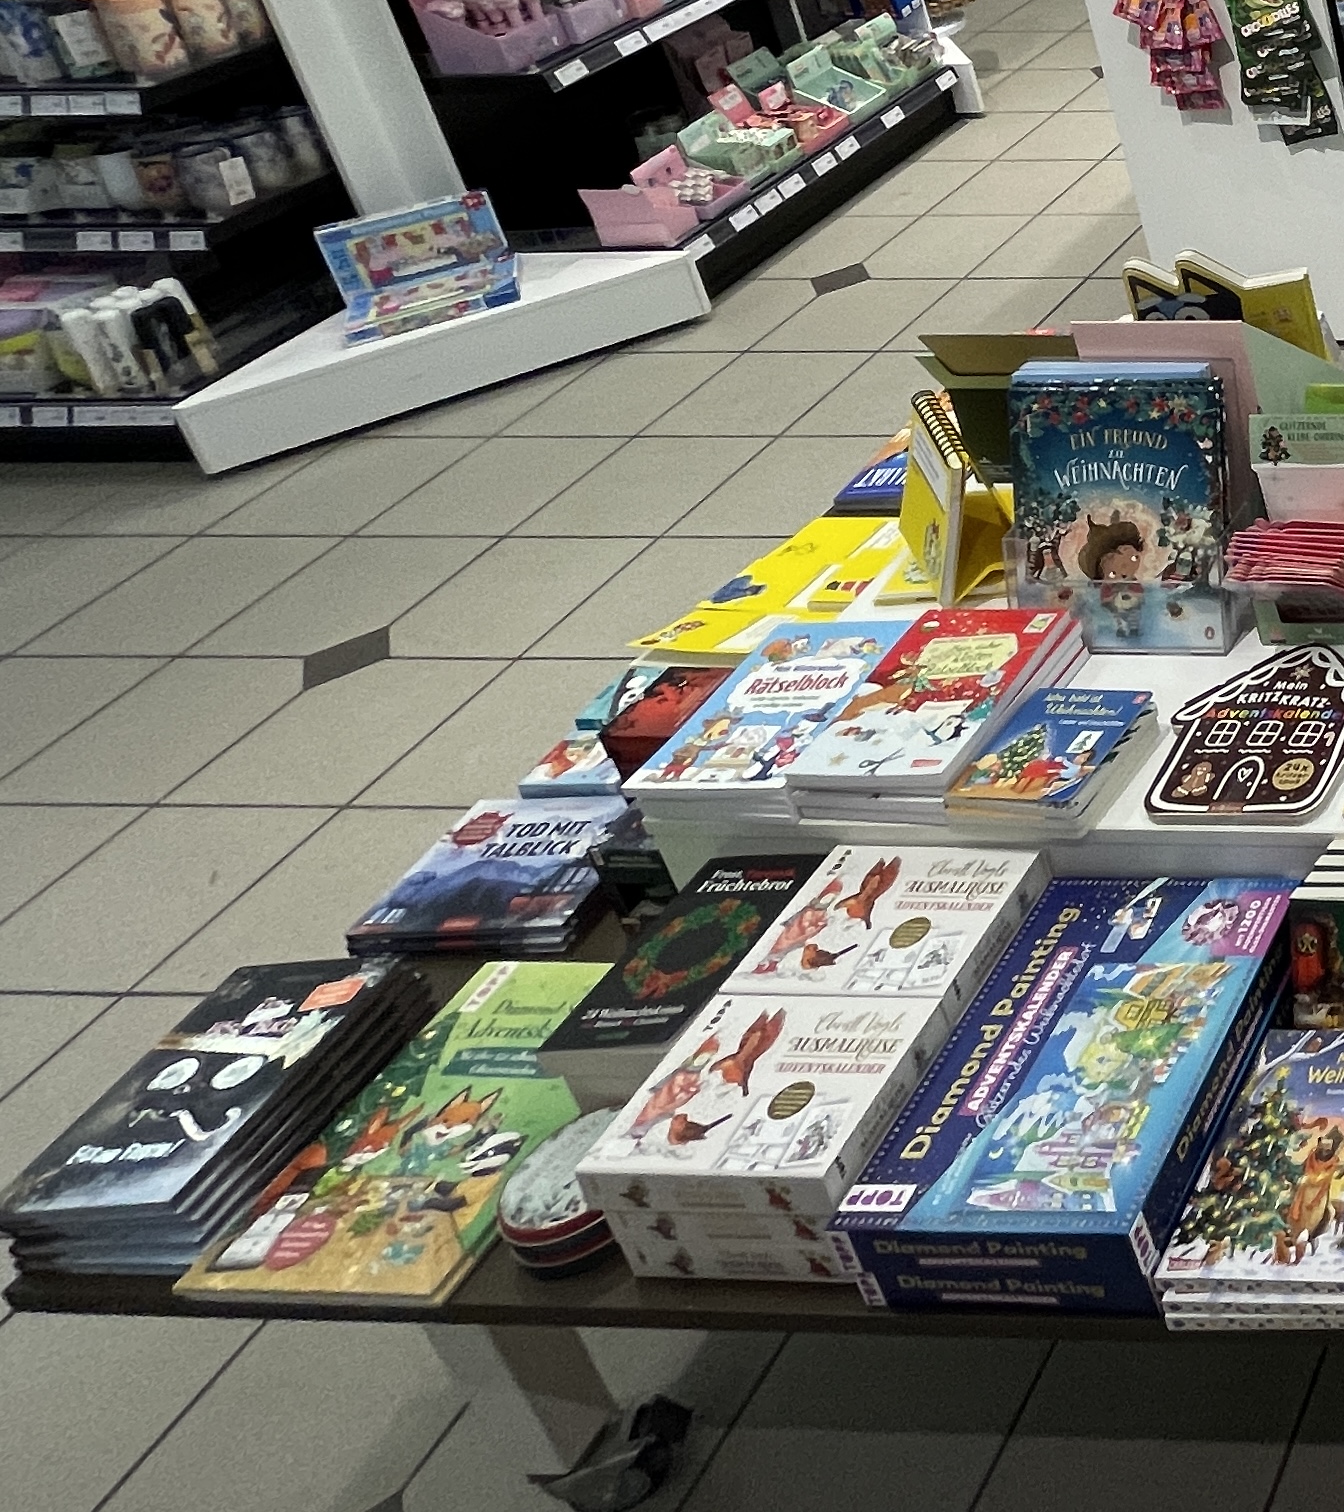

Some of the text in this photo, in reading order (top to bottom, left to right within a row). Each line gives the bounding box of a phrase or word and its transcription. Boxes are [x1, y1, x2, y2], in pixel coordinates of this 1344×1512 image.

[1069, 429, 1097, 451] EIN
[745, 672, 850, 696] Rätselblock
[1272, 680, 1309, 691] Mein
[1236, 690, 1332, 708] KRITZKRATZ-
[505, 820, 592, 838] TOD MIT
[480, 839, 581, 859] TALBLICK
[696, 878, 795, 894] Früchtebrot
[1241, 899, 1263, 933] 1200
[900, 904, 1081, 1162] Diamond Painting
[966, 951, 1074, 1113] ADVENTSKALENDER
[846, 1188, 906, 1207] TOPP
